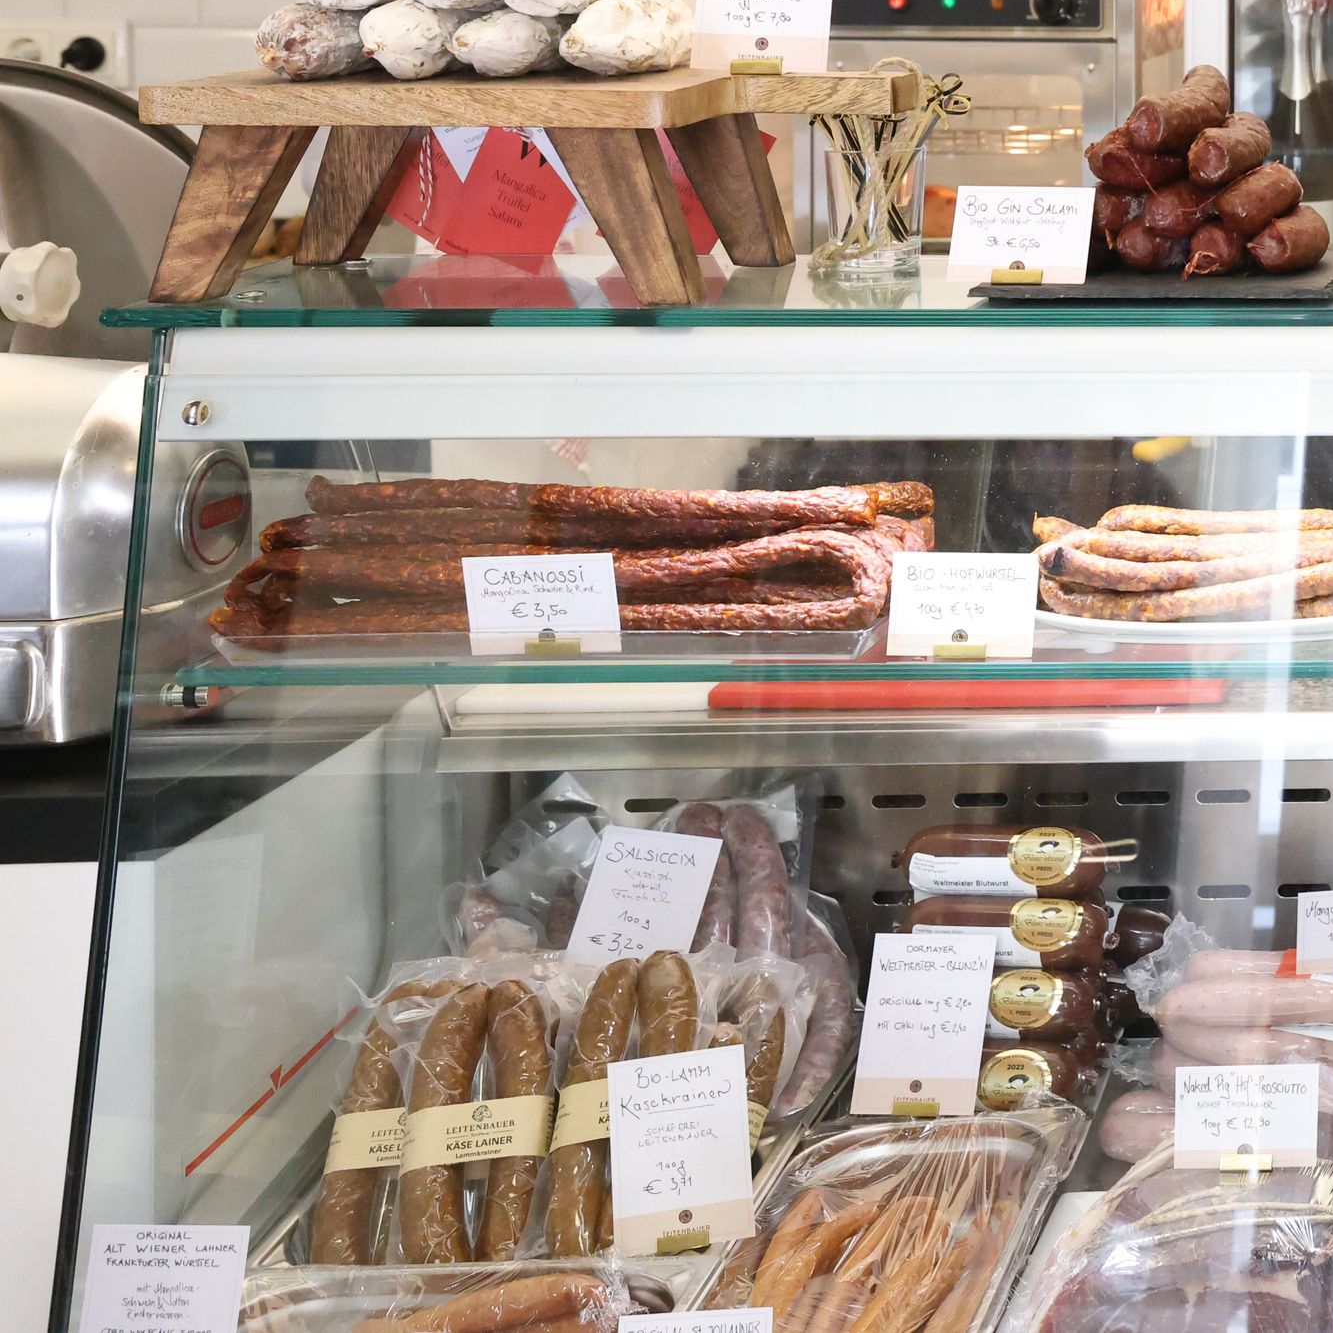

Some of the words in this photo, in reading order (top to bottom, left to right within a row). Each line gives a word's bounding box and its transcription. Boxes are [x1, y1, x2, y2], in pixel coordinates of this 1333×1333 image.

[1020, 238, 1041, 252] 6,50
[510, 602, 528, 618] €
[533, 603, 568, 622] 3,50
[608, 932, 643, 956] 3,20
[446, 1119, 515, 1135] LEITENBAUER
[369, 1143, 395, 1154] KÄSE
[446, 1140, 473, 1152] KÄSE
[475, 1135, 513, 1147] LAINER
[455, 1148, 502, 1159] Lammkrainer
[662, 1225, 711, 1238] LEITENBAUER
[103, 1243, 127, 1254] ALT
[136, 1245, 186, 1254] WIENER
